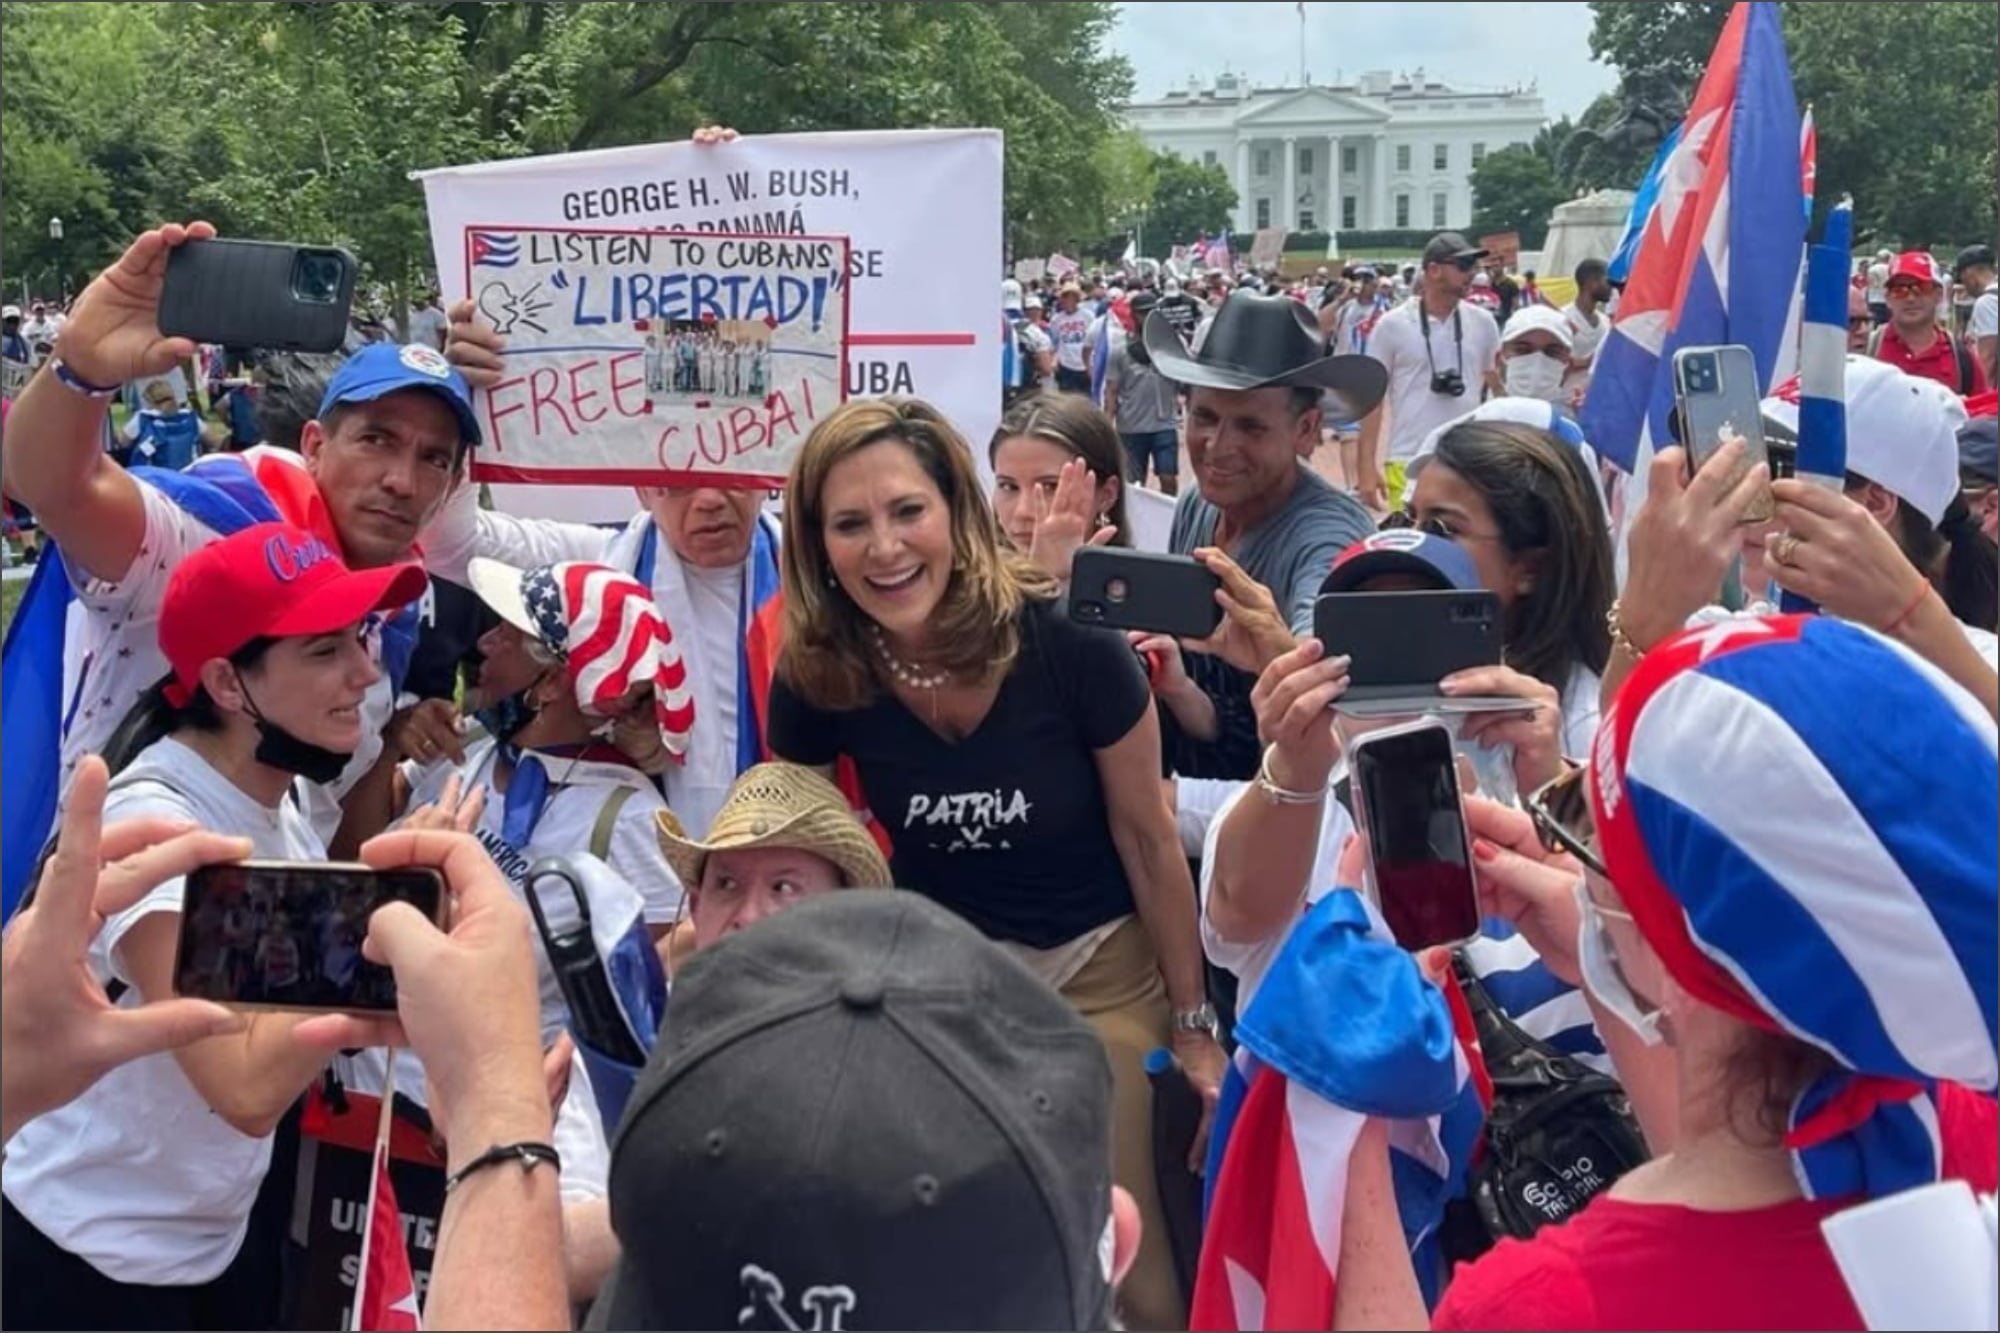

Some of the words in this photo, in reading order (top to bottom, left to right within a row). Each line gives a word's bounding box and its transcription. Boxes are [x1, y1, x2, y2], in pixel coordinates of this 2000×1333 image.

[563, 180, 680, 221] GEORGE
[688, 177, 719, 207] H.
[726, 170, 757, 203] W.
[767, 169, 859, 201] BUSH,
[530, 233, 652, 265] LISTEN
[670, 238, 705, 266] TO
[717, 240, 833, 270] CUBANS
[846, 360, 915, 396] UBA
[487, 351, 650, 452] FREE
